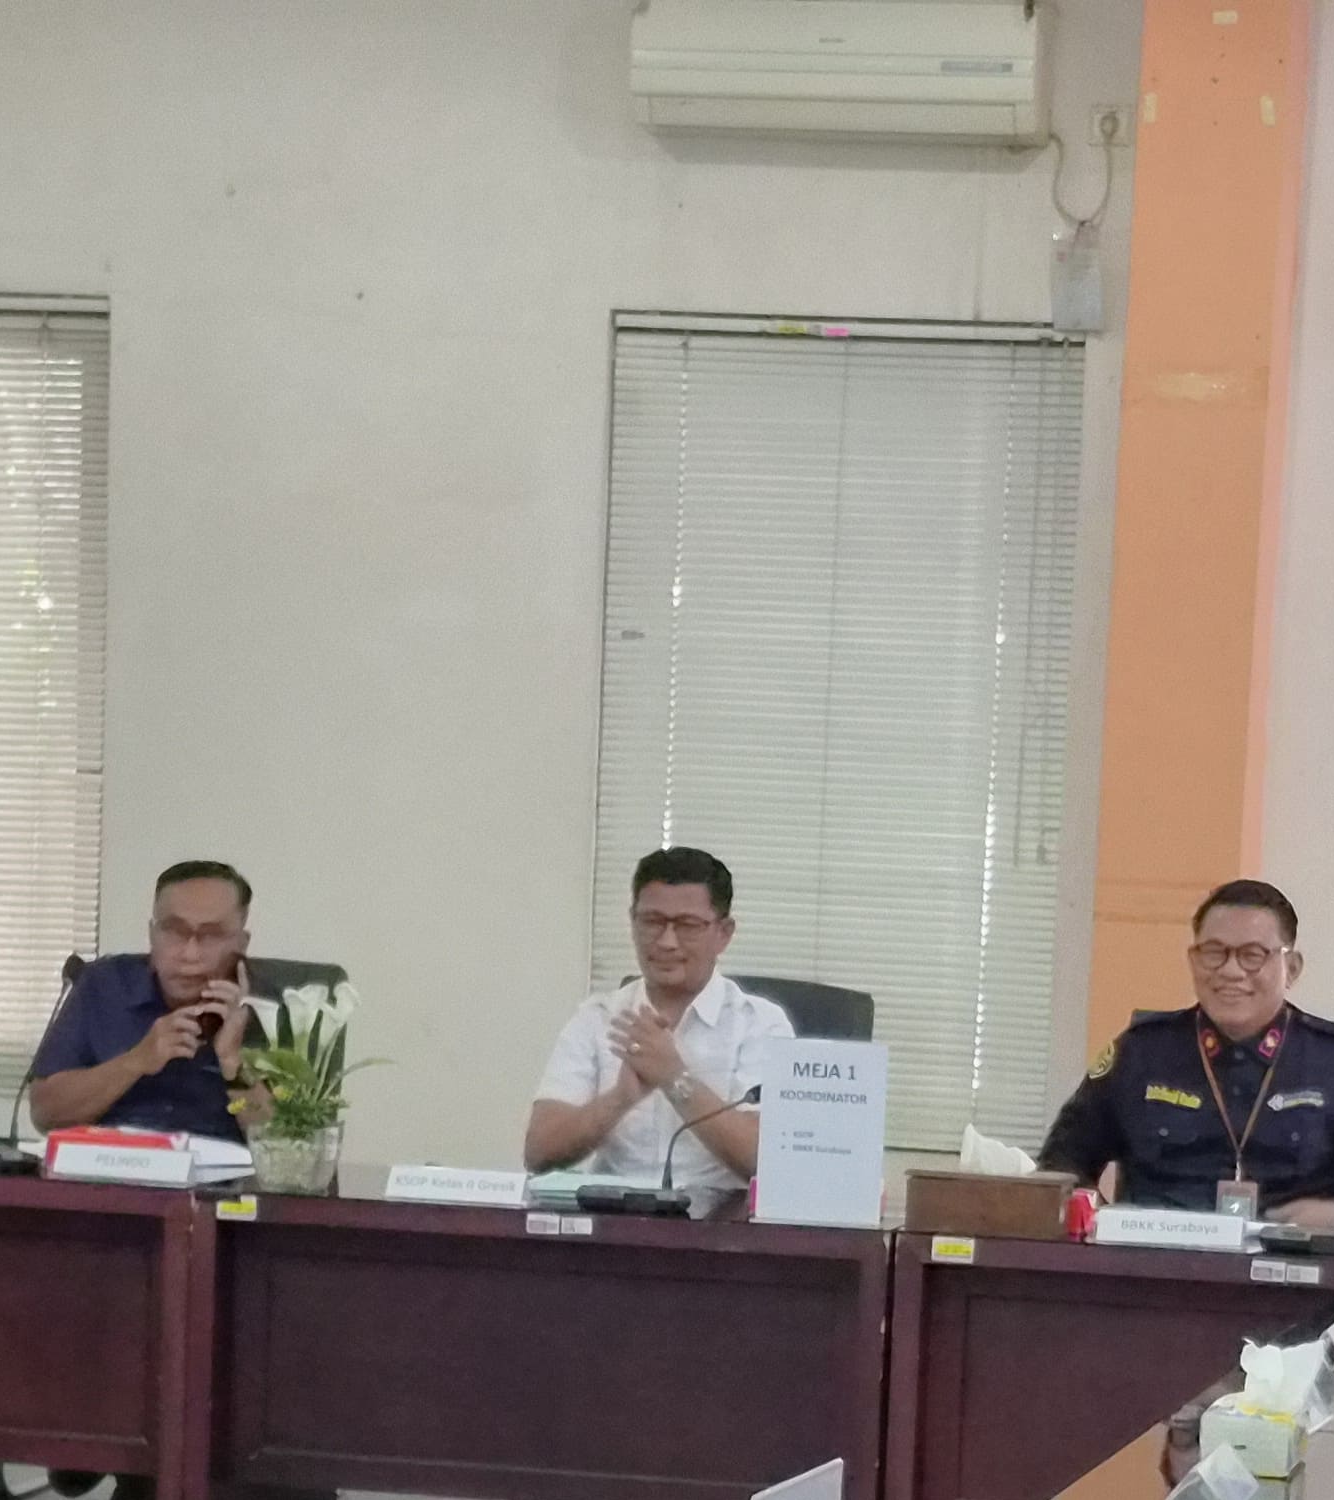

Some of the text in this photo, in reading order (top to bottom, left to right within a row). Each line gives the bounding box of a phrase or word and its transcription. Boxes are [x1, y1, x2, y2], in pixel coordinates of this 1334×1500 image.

[793, 1062, 856, 1080] MEJA 1
[779, 1089, 867, 1105] KOORDINATOR
[1121, 1219, 1219, 1235] BBKK Surabaya
